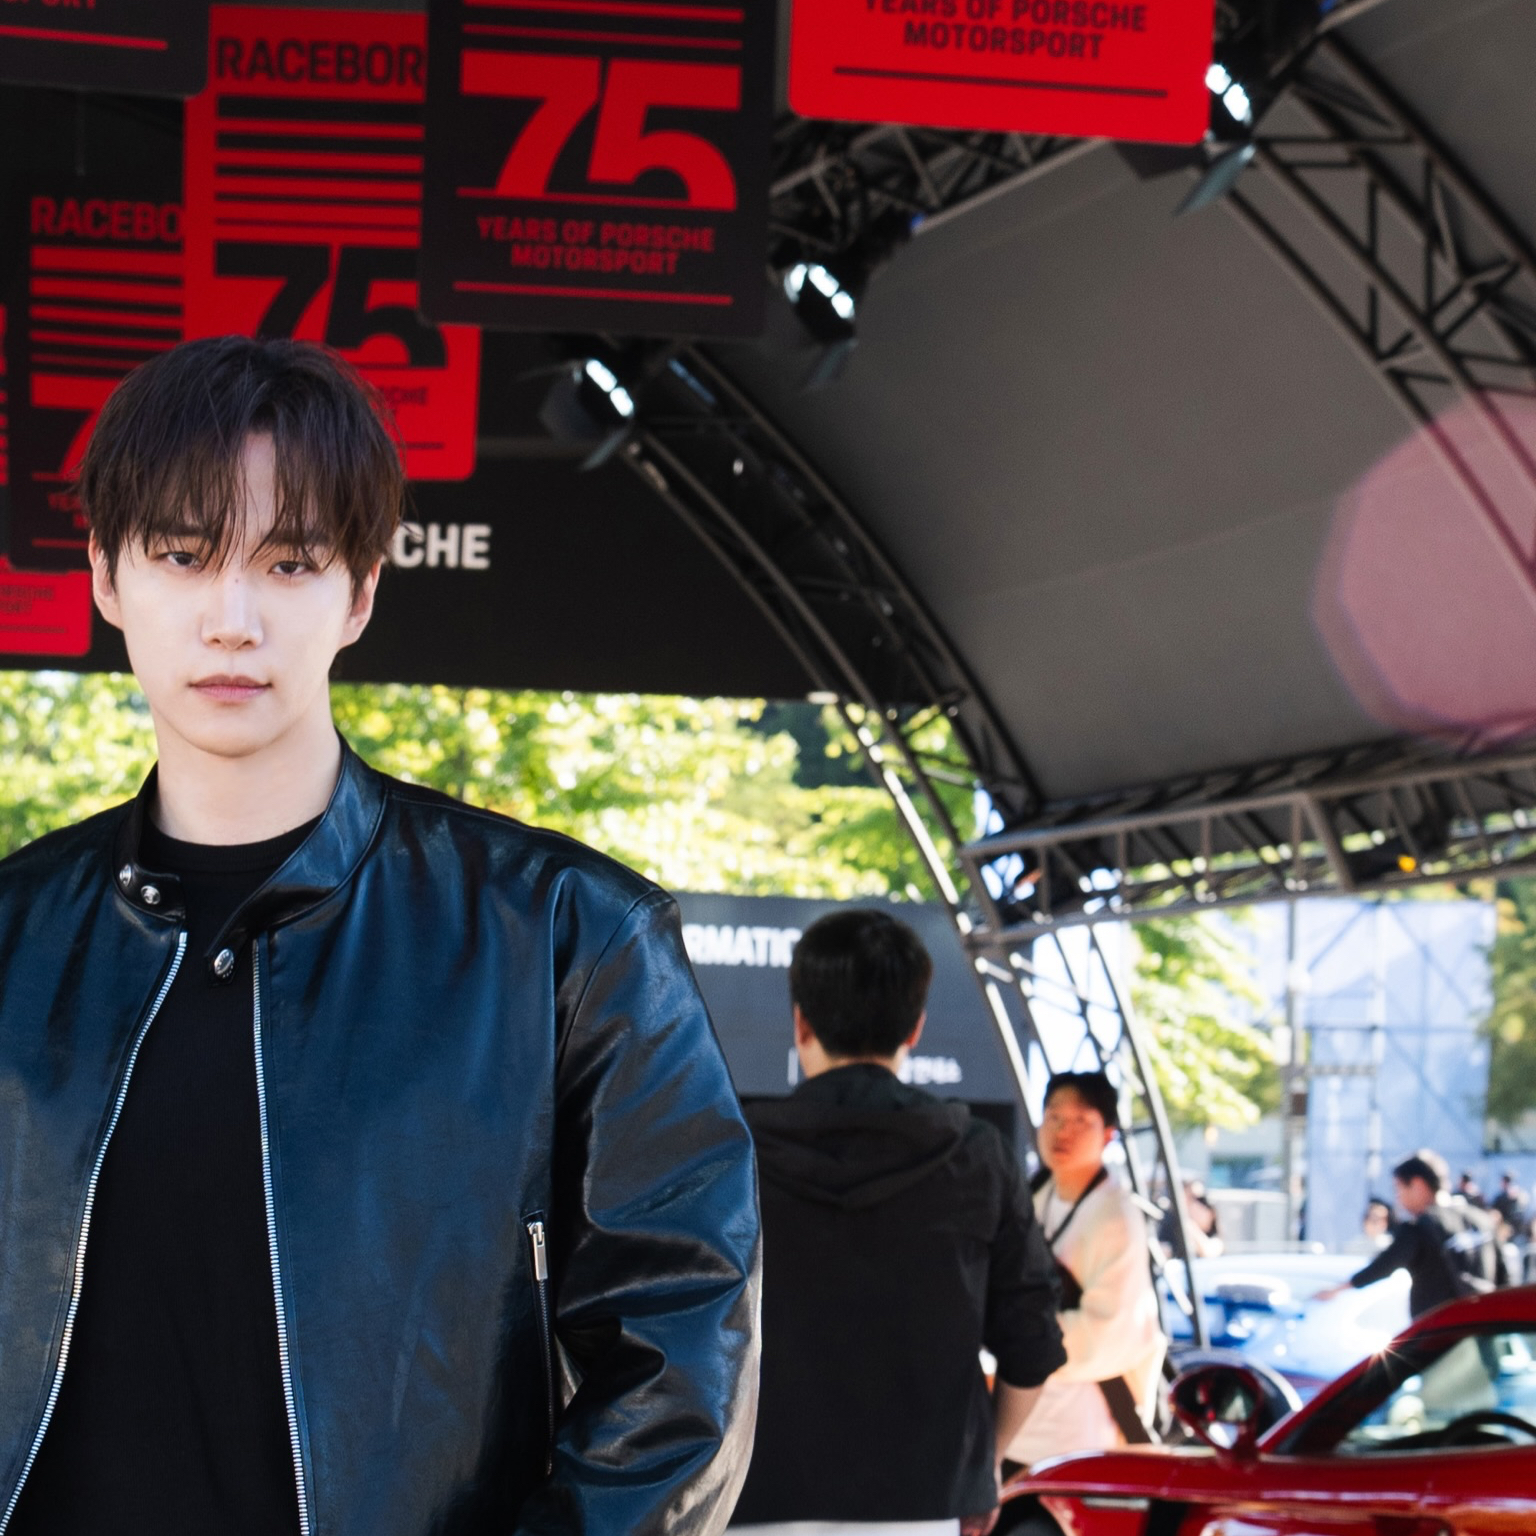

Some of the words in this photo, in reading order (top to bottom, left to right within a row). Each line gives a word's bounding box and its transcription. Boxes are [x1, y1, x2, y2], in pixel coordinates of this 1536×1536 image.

[1010, 0, 1149, 32] PORSCHE
[903, 20, 1105, 60] MOTORSPORT
[215, 37, 426, 87] RACEBOR
[460, 49, 742, 211] 75
[476, 216, 557, 242] YEARS
[562, 219, 594, 244] OF
[600, 221, 716, 253] PORSCHE
[509, 243, 679, 274] MOTORSPORT
[215, 240, 448, 368] 75
